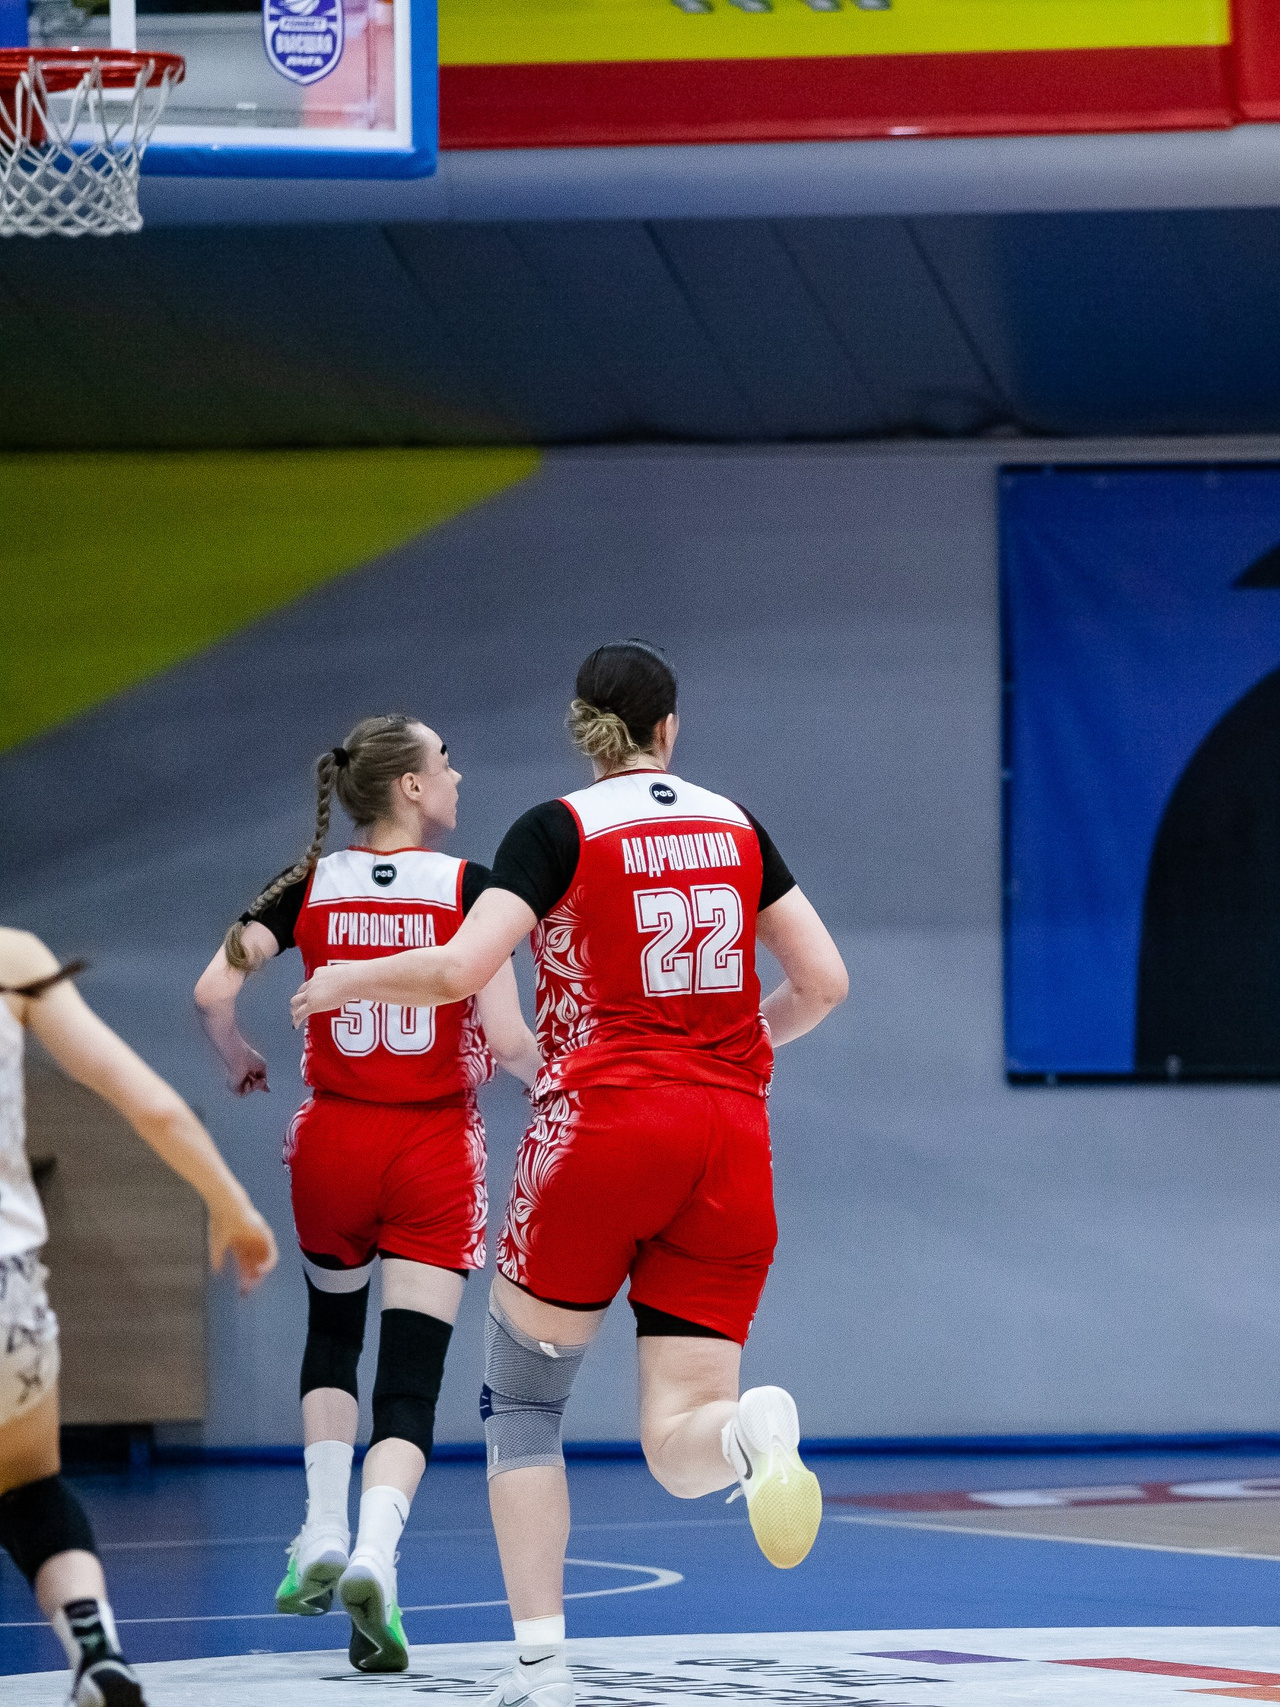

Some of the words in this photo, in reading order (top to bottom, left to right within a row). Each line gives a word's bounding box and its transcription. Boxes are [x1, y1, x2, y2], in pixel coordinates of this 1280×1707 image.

[653, 789, 674, 798] РФБ
[375, 869, 394, 878] РФБ
[621, 832, 741, 877] АНДРЮШКИНА
[327, 911, 436, 947] КРИВОШЕИНА
[633, 883, 743, 998] 22
[327, 960, 436, 1057] 30
